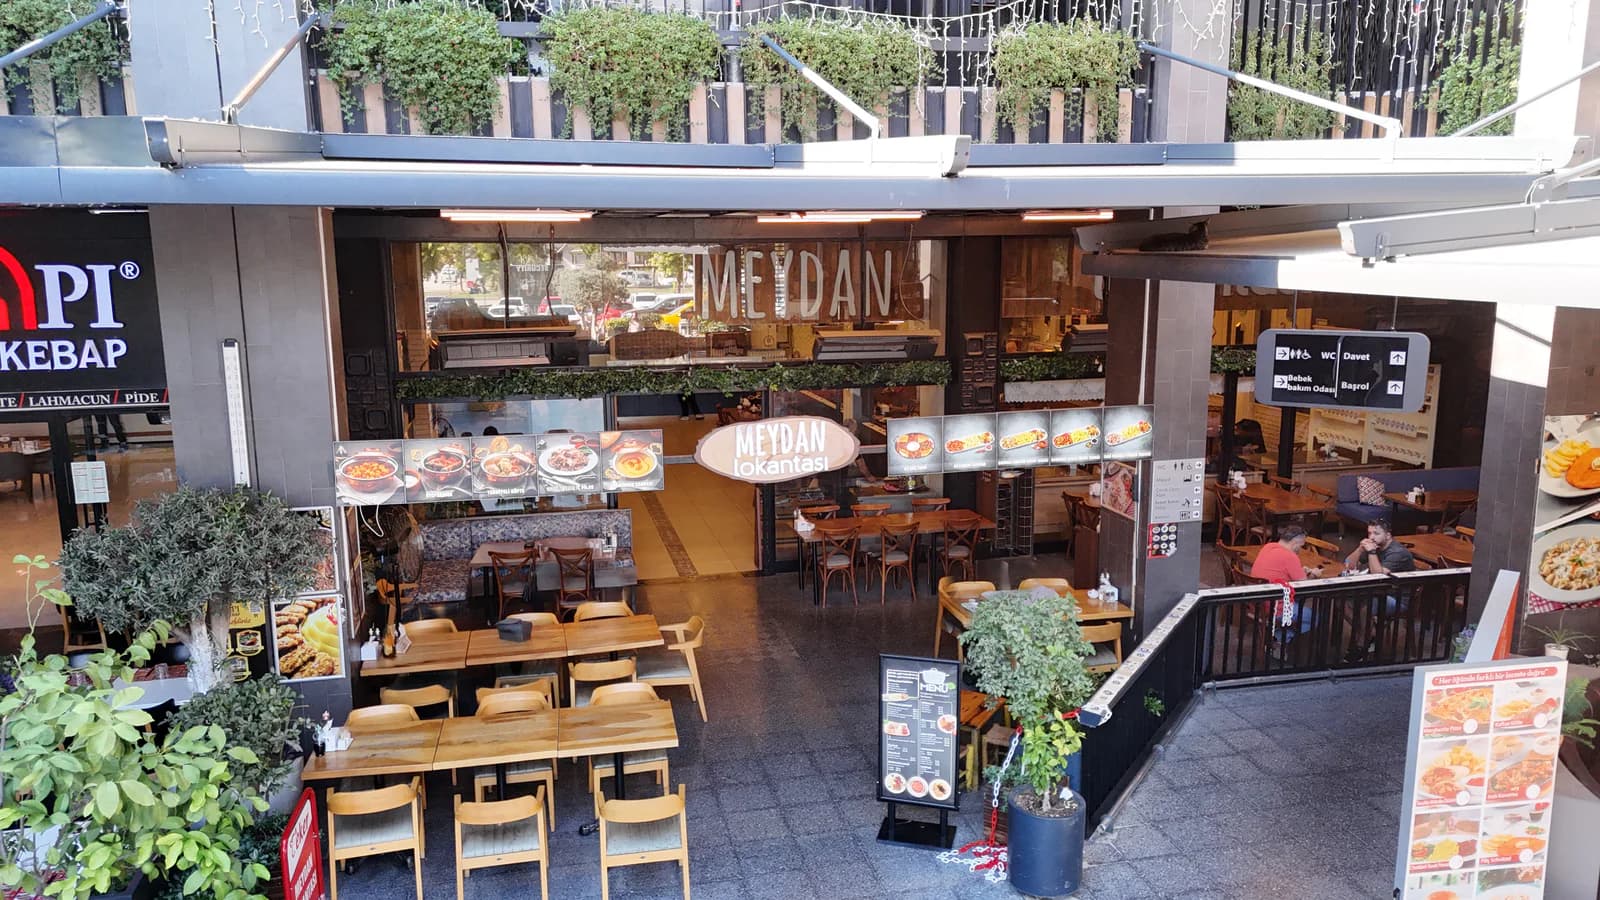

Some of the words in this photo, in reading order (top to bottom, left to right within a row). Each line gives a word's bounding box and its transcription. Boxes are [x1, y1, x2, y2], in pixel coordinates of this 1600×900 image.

[702, 249, 892, 320] MEYDAN
[0, 338, 127, 371] KEBAP
[1321, 351, 1337, 360] WC
[1343, 351, 1371, 361] Davet
[1288, 374, 1312, 382] Bebek
[1341, 381, 1370, 391] Başrol
[29, 393, 111, 407] LAHMACUN
[125, 390, 160, 404] PİDE
[735, 420, 827, 459] MEYDAN
[733, 455, 829, 477] lokantası
